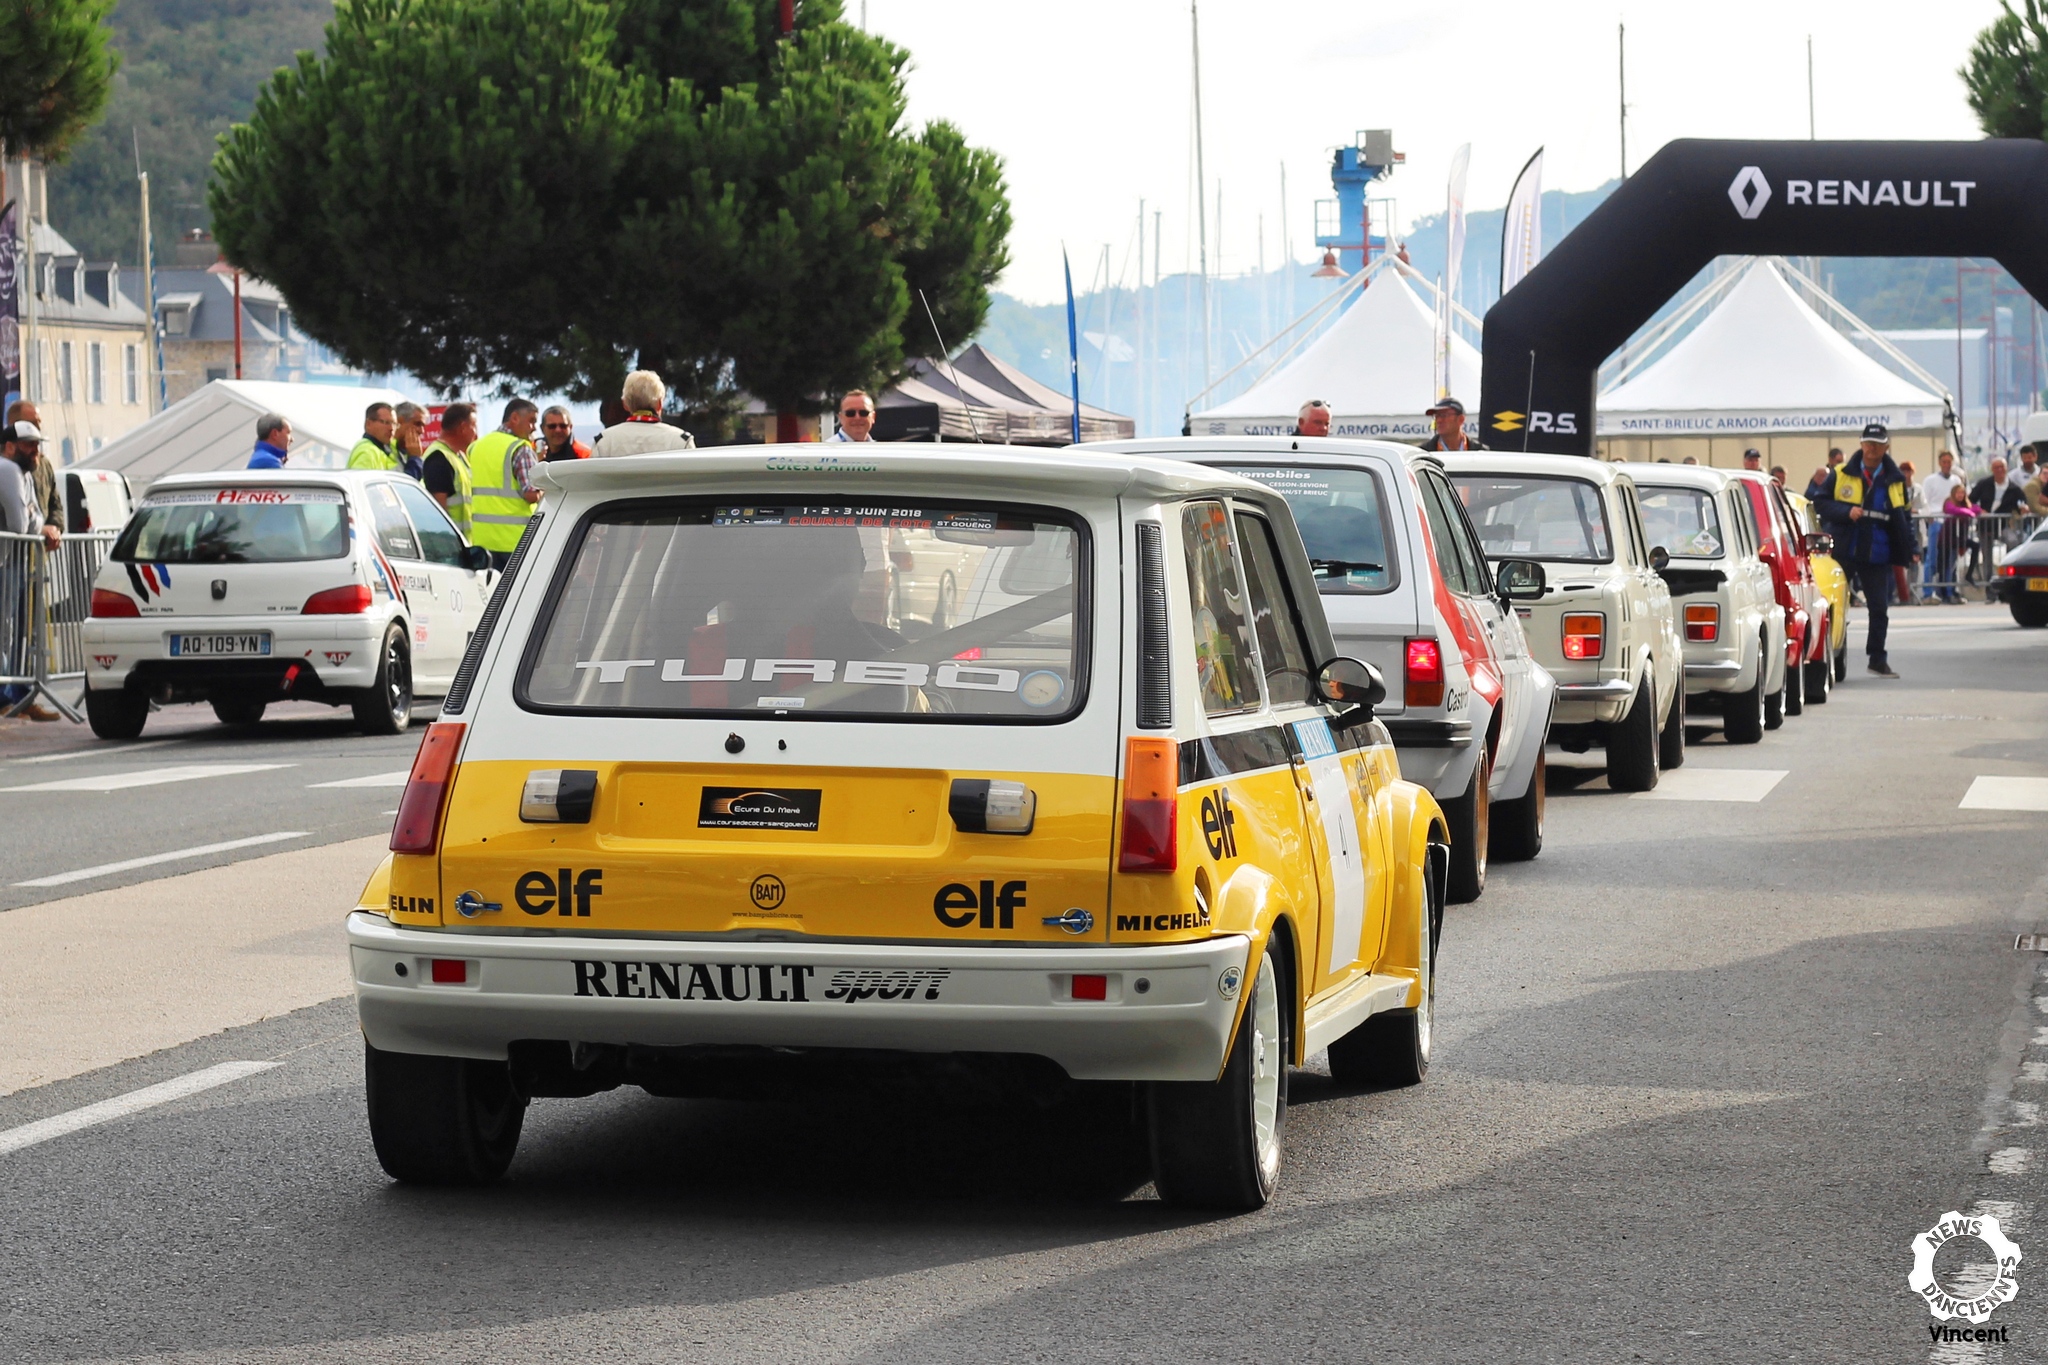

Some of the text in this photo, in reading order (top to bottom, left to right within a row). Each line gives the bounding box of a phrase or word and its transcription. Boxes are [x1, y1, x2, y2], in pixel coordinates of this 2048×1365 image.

[1787, 180, 1977, 207] RENAULT
[1337, 424, 1389, 435] ARMOR
[1621, 413, 1890, 430] SAINT-BRIEUC ARMOR AGGLOMÉRATION
[766, 457, 880, 472] Côtes d'Armor
[1268, 481, 1329, 489] CESSON-SEVIGNE
[216, 489, 290, 504] HENRY
[803, 507, 808, 515] 1
[821, 507, 830, 515] 2
[843, 507, 852, 515] 3
[856, 508, 887, 516] JUIN
[891, 508, 922, 518] 2018
[788, 517, 856, 527] COURSE
[862, 517, 884, 527] DE
[889, 518, 933, 529] COTE
[100, 657, 114, 668] AD
[328, 652, 347, 664] AD
[576, 659, 1020, 692] TURBO
[1201, 787, 1237, 861] elf
[514, 868, 603, 917] elf
[756, 884, 779, 901] BAM
[933, 880, 1026, 929] elf
[571, 960, 951, 1003] RENAULT sport
